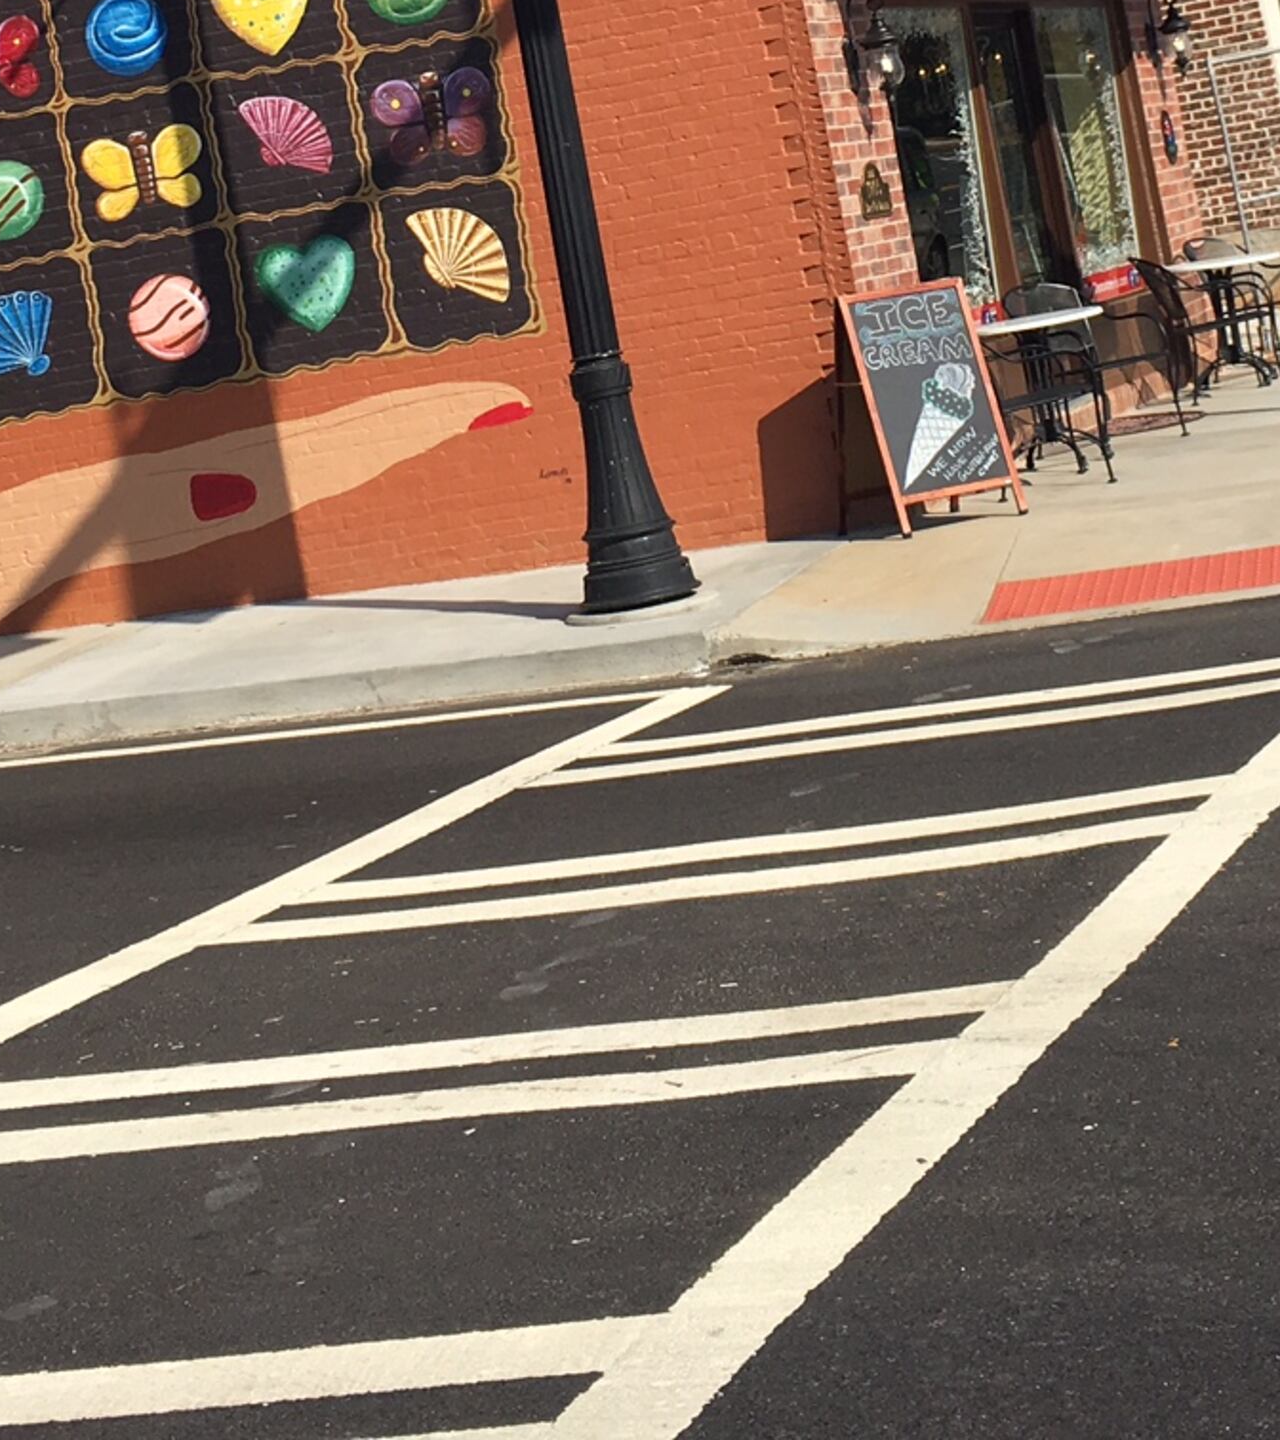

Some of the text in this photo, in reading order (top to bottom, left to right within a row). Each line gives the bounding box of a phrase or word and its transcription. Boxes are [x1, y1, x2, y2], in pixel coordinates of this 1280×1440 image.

[863, 292, 954, 340] ICE
[863, 332, 974, 370] CREAM
[926, 425, 977, 477] WE NOW
[942, 454, 968, 481] HAVE
